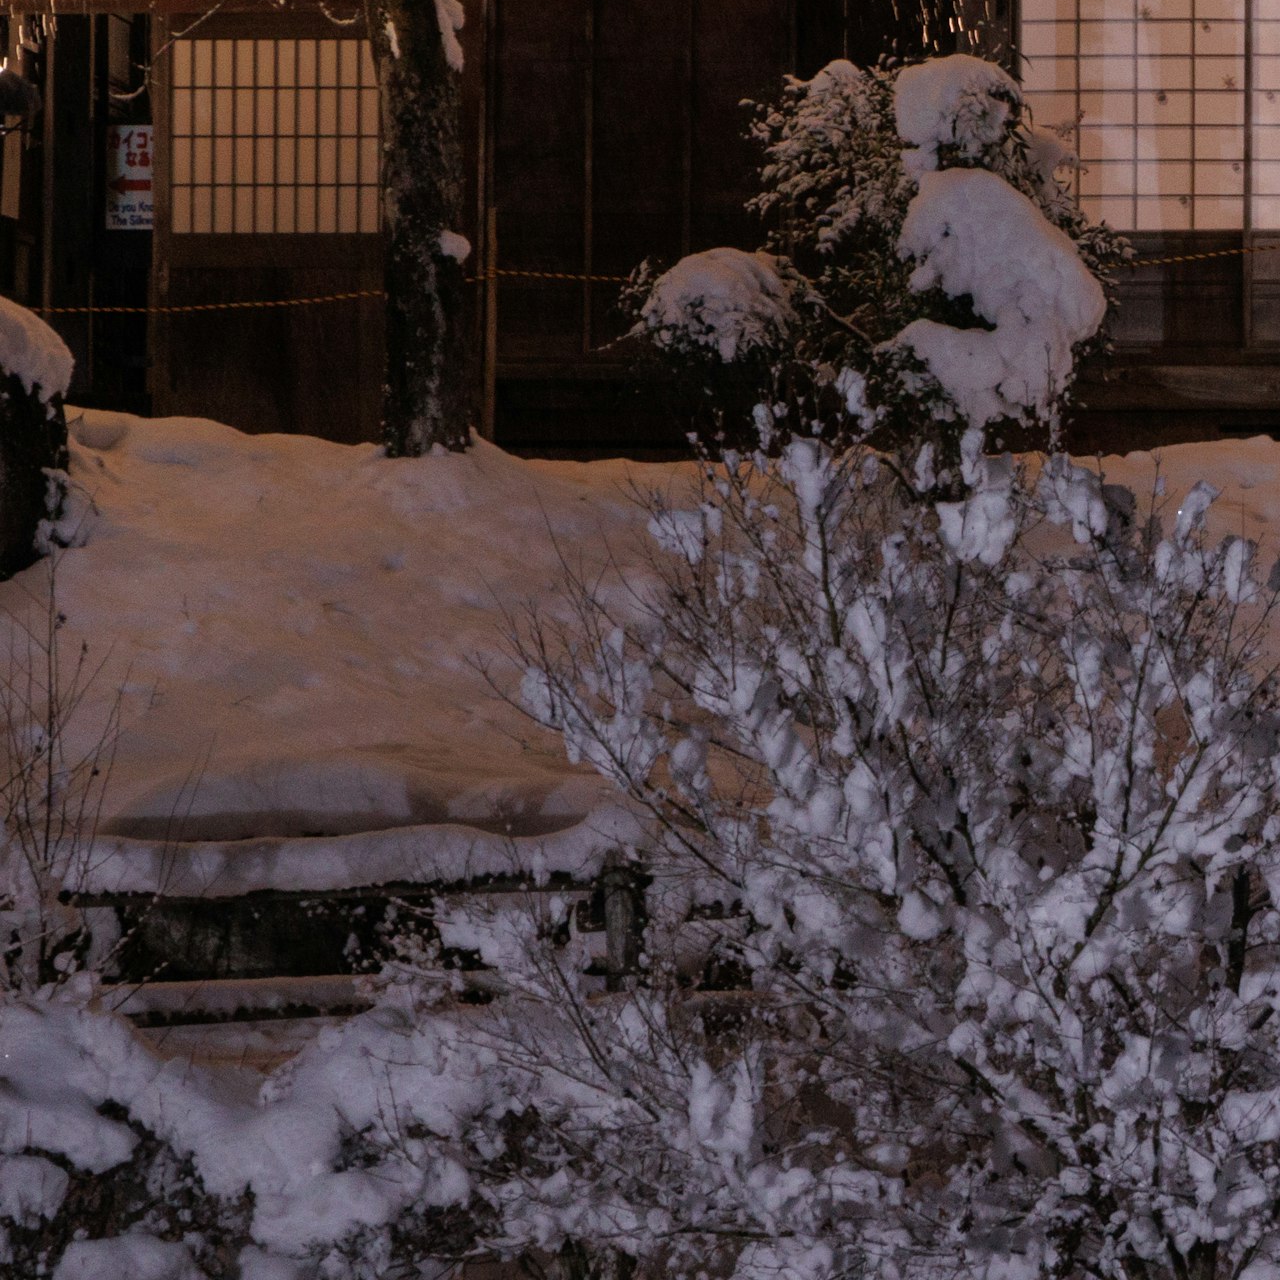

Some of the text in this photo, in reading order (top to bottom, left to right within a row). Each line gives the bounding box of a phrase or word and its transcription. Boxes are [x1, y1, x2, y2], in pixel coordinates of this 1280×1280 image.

[109, 130, 153, 150] カイコ
[112, 215, 127, 225] The
